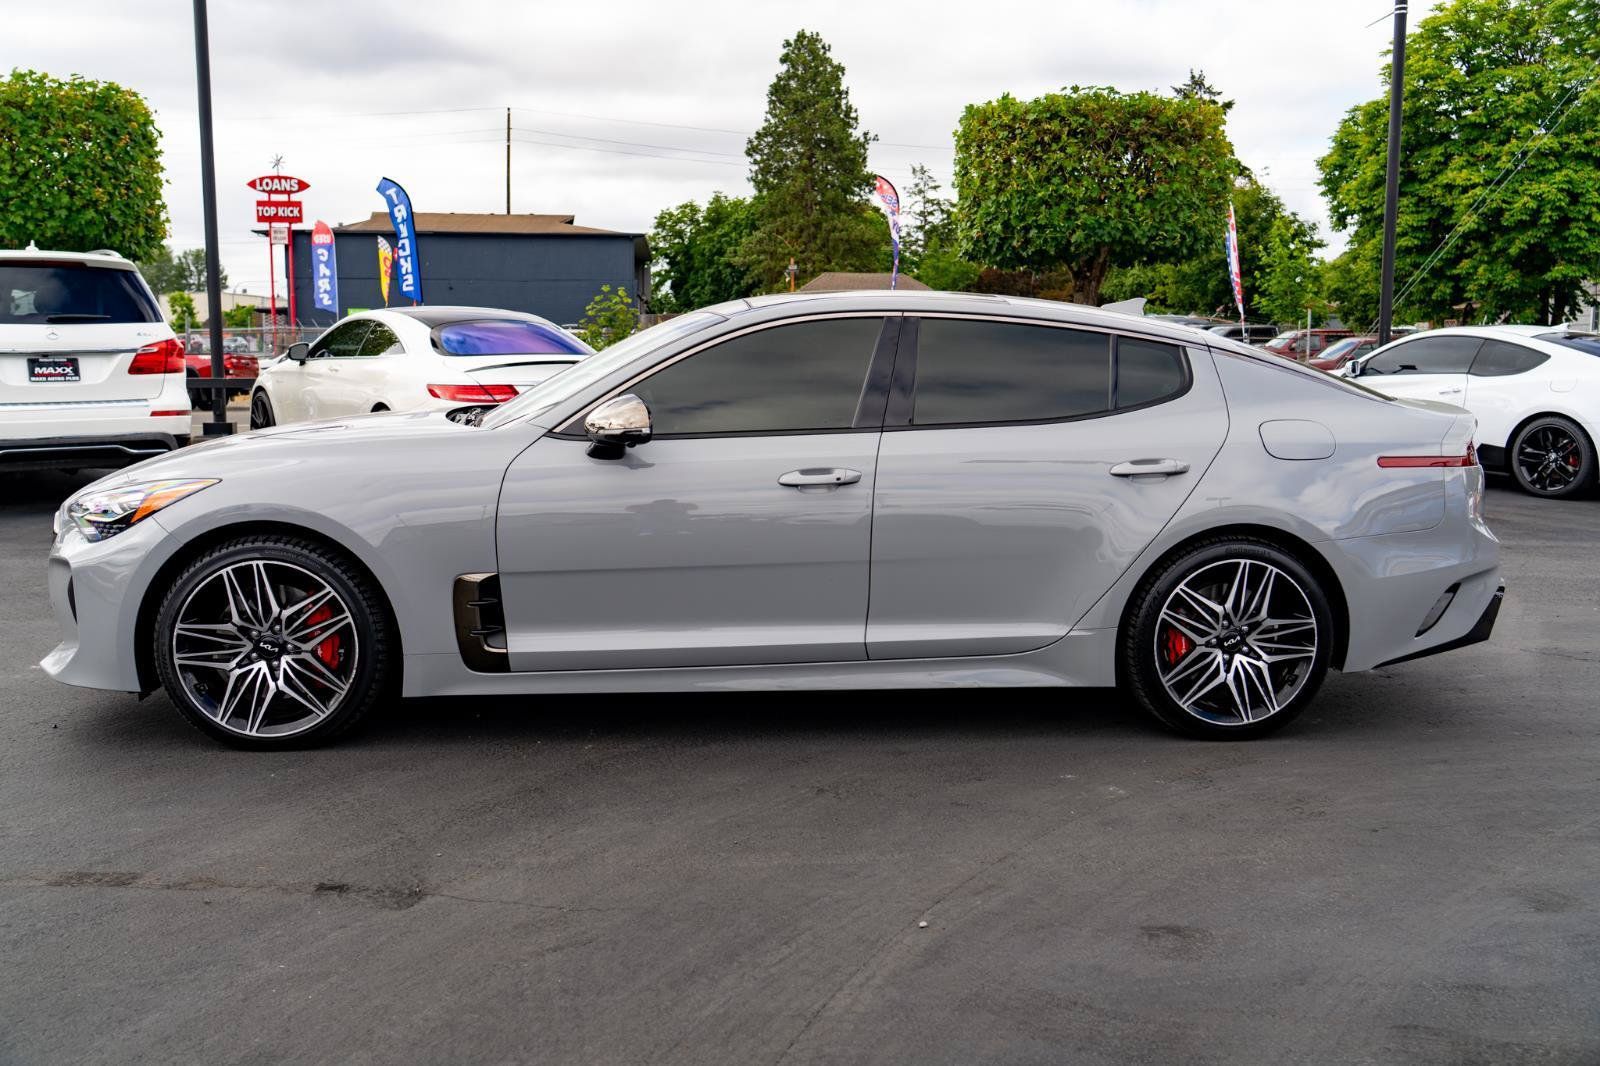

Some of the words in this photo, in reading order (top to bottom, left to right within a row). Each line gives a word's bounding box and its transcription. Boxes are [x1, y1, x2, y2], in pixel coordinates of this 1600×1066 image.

[256, 178, 299, 191] LOANS
[257, 206, 277, 217] TOP
[278, 206, 300, 217] KICK
[34, 366, 73, 374] MAXX
